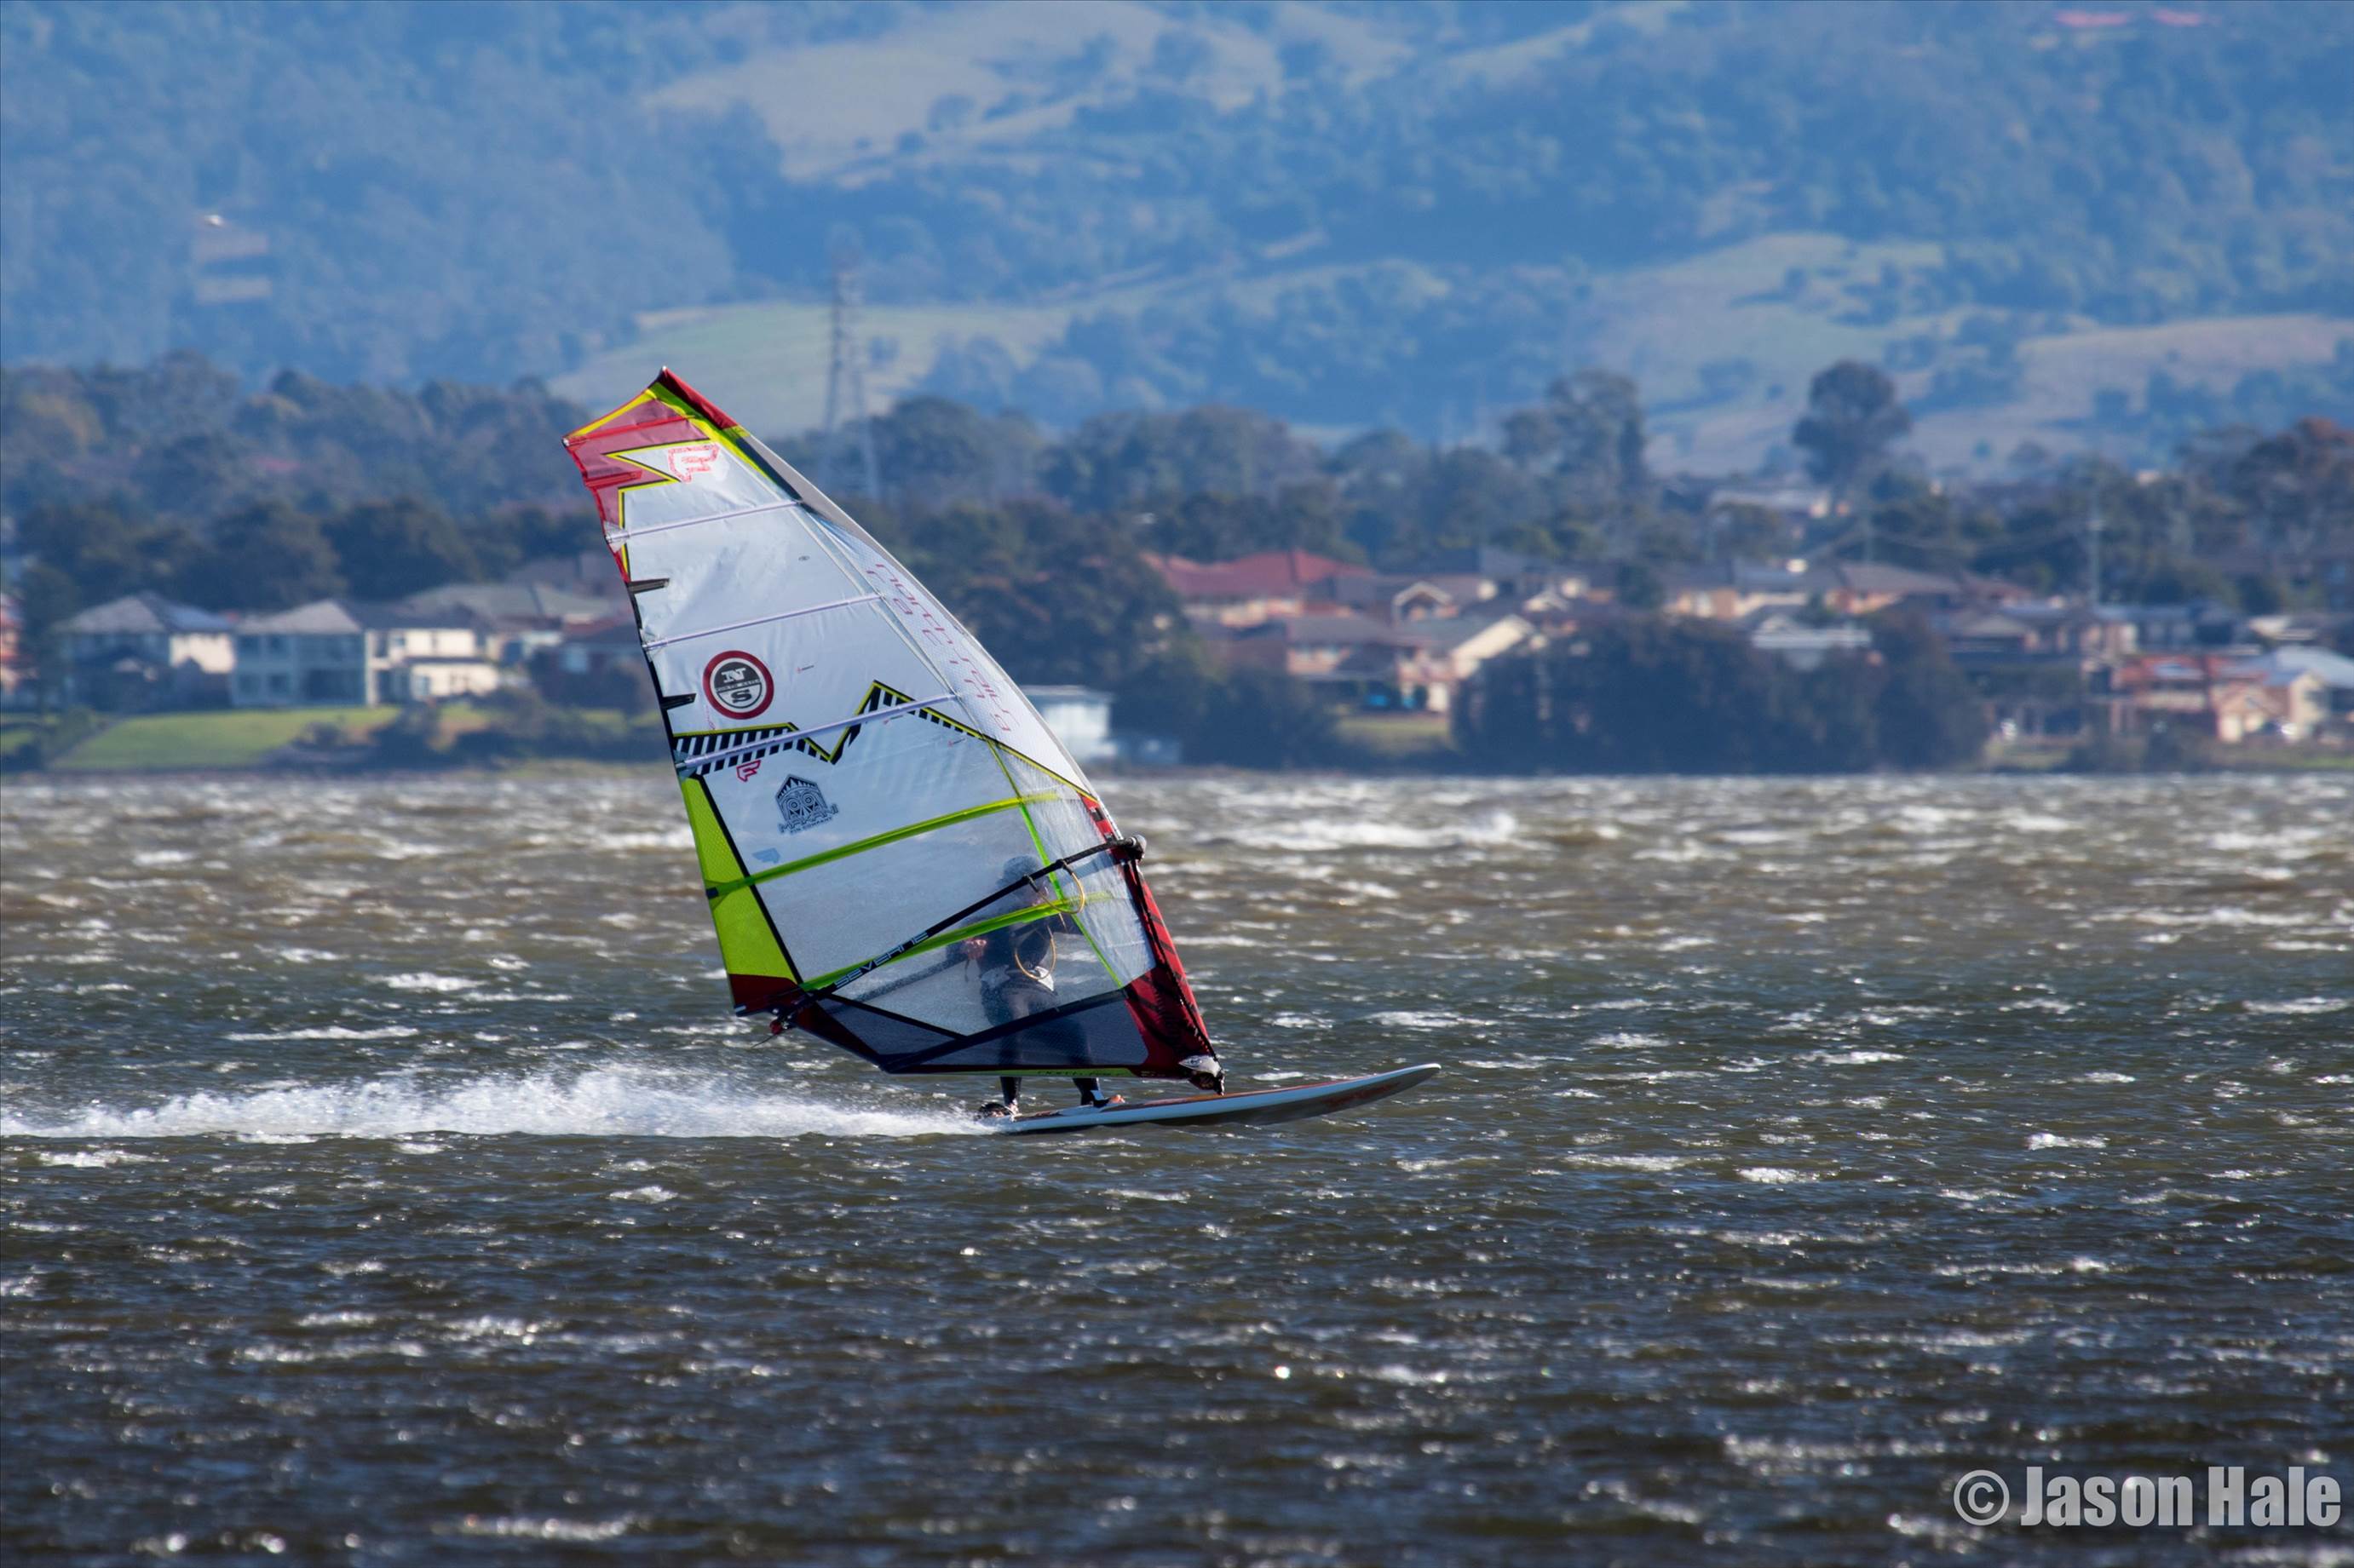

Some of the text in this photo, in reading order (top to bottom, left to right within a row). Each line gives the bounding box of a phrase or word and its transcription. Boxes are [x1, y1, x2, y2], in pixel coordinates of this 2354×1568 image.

[721, 667, 746, 683] N
[731, 688, 752, 704] S
[834, 931, 930, 988] SEVERNE
